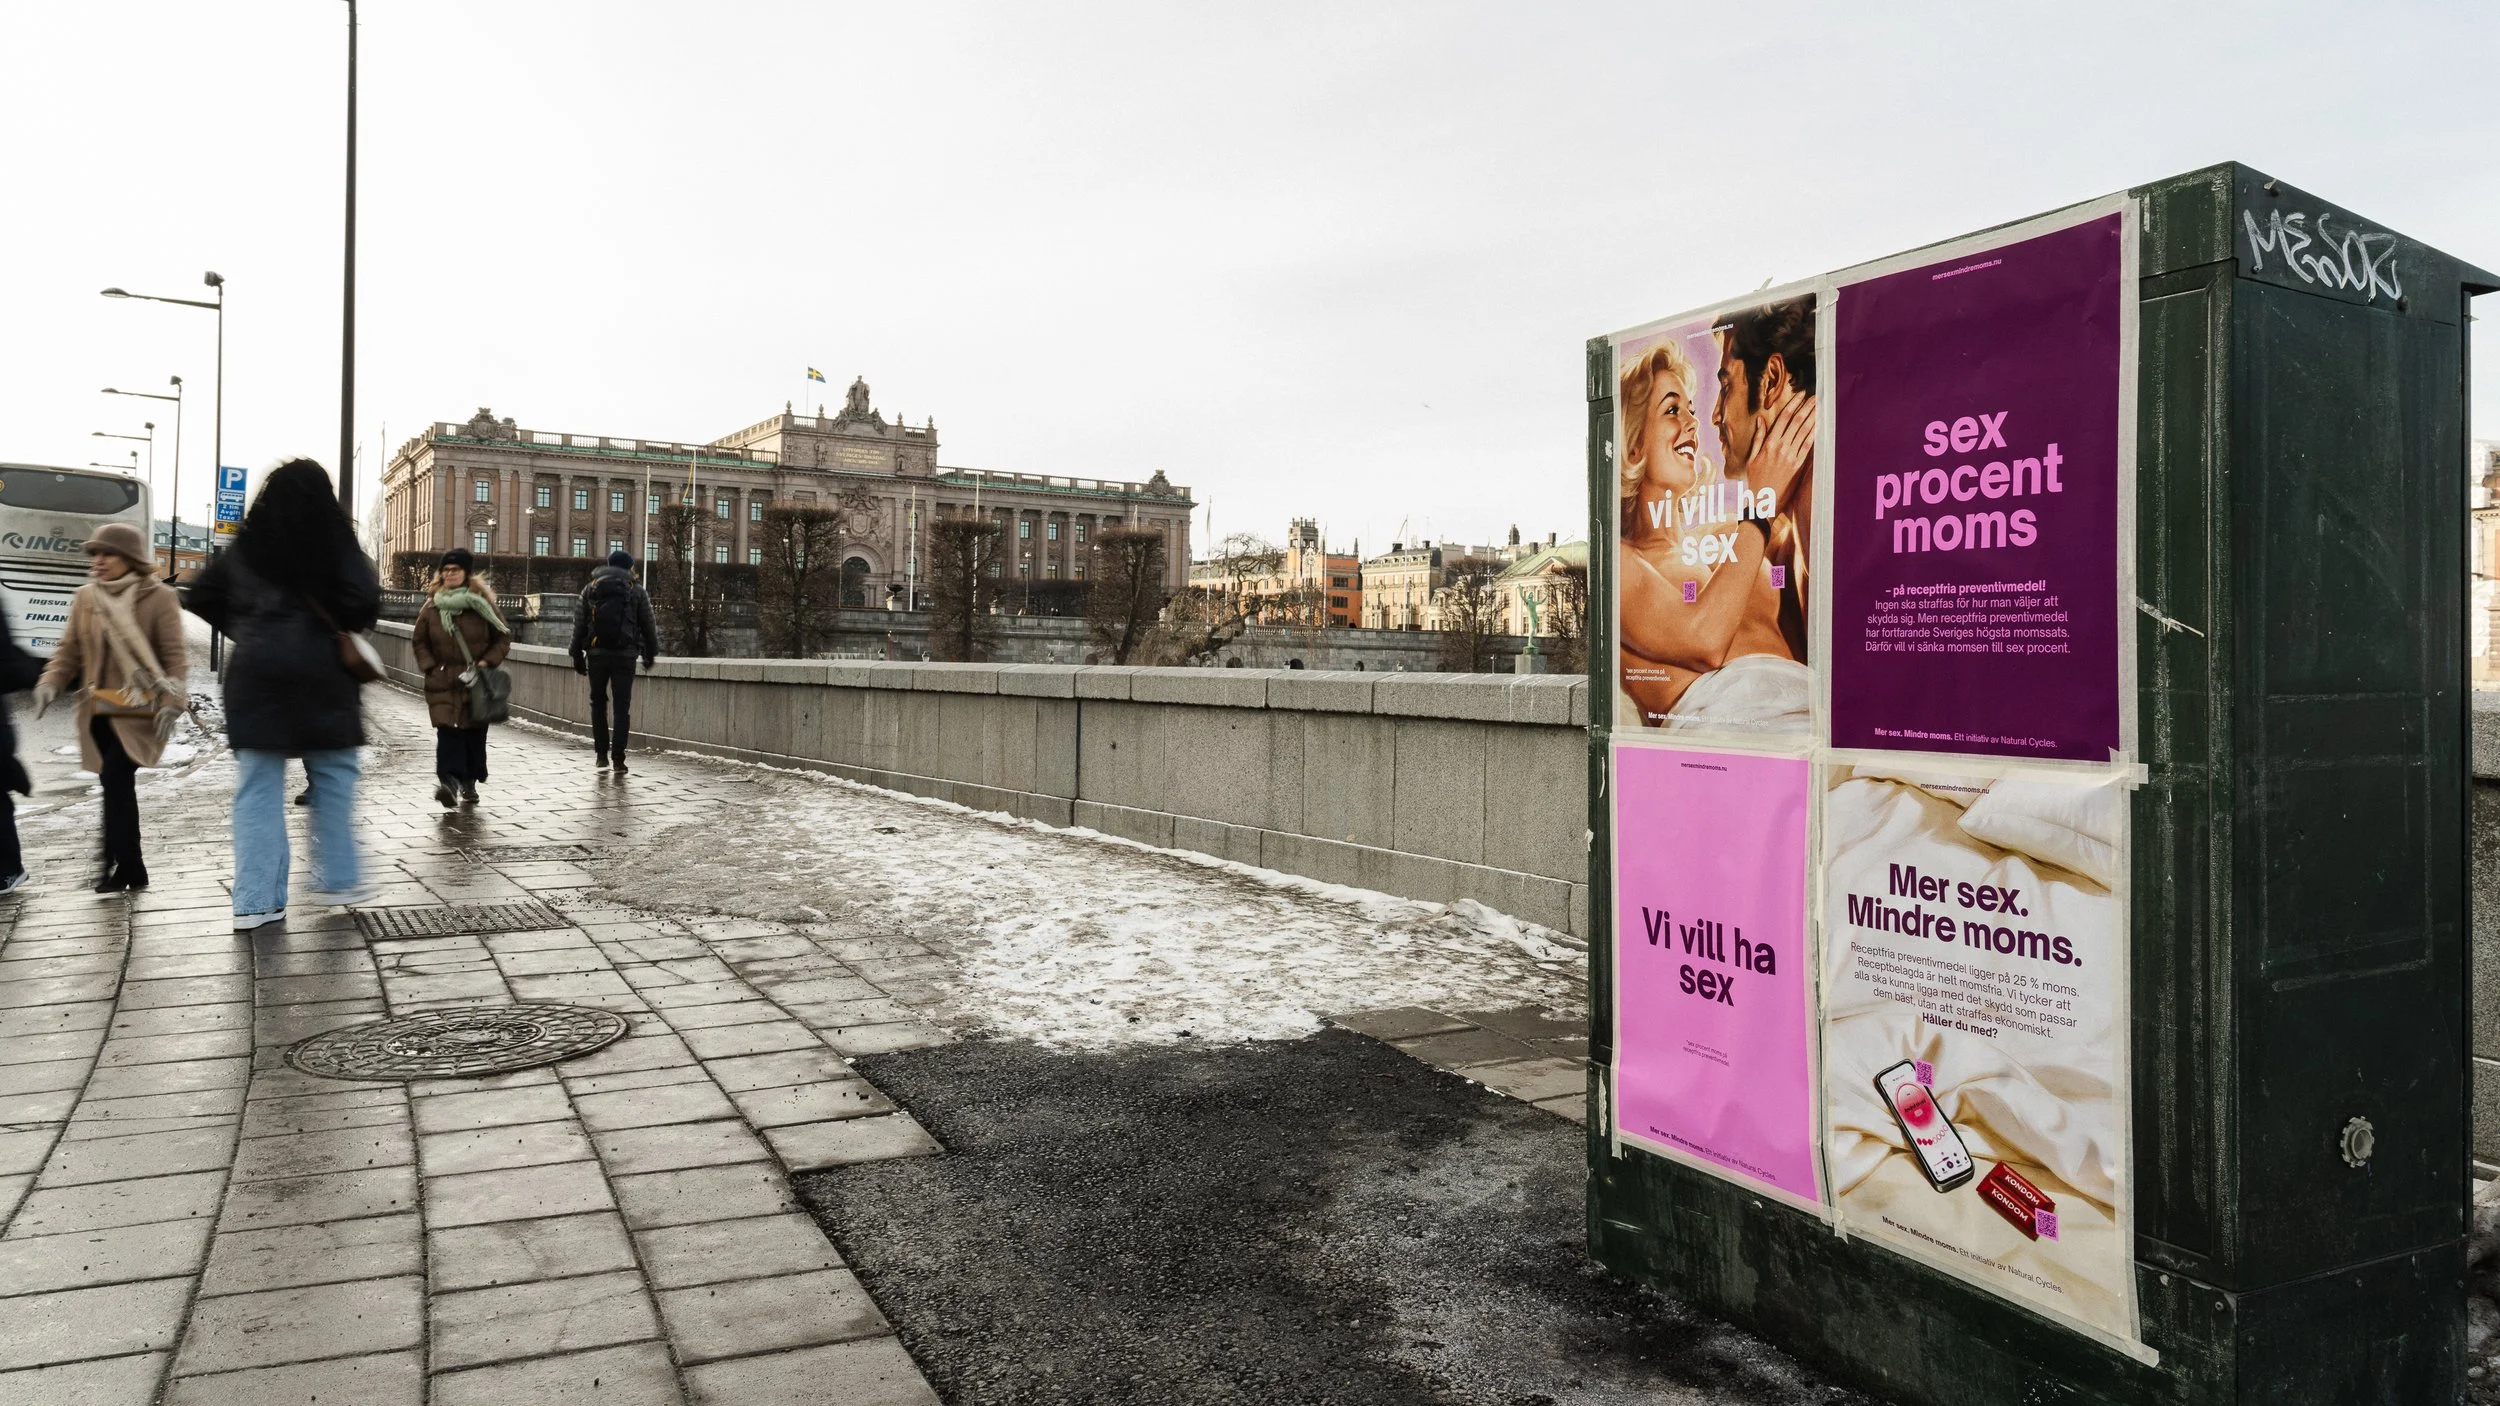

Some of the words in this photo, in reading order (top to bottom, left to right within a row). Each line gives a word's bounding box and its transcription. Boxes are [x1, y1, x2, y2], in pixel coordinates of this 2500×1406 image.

[1924, 411, 2008, 456] sex
[226, 469, 242, 488] P
[1876, 443, 2063, 520] procent
[1648, 490, 1672, 528] vi
[1680, 483, 1726, 526] vill
[1737, 481, 1776, 521] ha
[25, 536, 82, 552] INGS
[1894, 508, 2037, 553] moms
[1682, 532, 1738, 566] sex
[28, 598, 73, 607] ingsva.
[1875, 600, 1898, 612] Ingen
[1901, 600, 1916, 609] ska
[1918, 598, 1954, 609] straffas
[1956, 598, 1970, 608] för
[1972, 597, 1986, 608] hur
[1990, 598, 2012, 608] man
[2014, 596, 2042, 610] väljer
[2044, 596, 2059, 607] att
[1893, 584, 1904, 598] på
[1907, 583, 1956, 596] receptfria
[1958, 579, 2046, 596] preventivmedel!
[25, 613, 72, 622] FINLAN
[1866, 628, 1880, 638] har
[1882, 628, 1930, 638] fortfarande
[1933, 627, 1974, 640] Sveriges
[1976, 626, 2010, 640] högsta
[2014, 627, 2070, 638] momssats.
[1868, 613, 1898, 626] skydda
[1900, 612, 1916, 626] sig.
[1918, 613, 1938, 623] Men
[1941, 612, 1986, 625] receptfria
[1990, 611, 2068, 625] preventivmedel
[1866, 641, 1892, 652] Därför
[1894, 641, 1906, 652] vill
[1908, 642, 1916, 652] vi
[1917, 641, 1944, 652] sänka
[1948, 643, 1988, 653] momsen
[1992, 641, 2004, 653] till
[2006, 643, 2024, 653] sex
[2027, 642, 2070, 655] procent.
[1874, 728, 1887, 736] Mer
[1904, 730, 1928, 740] Mindre
[1930, 732, 1952, 741] moms.
[1954, 732, 1964, 742] Ett
[1966, 734, 1989, 743] initiativ
[1990, 736, 2000, 744] av
[2001, 735, 2027, 746] Natural
[2029, 738, 2058, 749] Cycles.
[1920, 782, 1990, 794] mersexmindremoms.nu
[1890, 862, 1950, 903] Mer
[1957, 882, 2028, 917] sex.
[1642, 906, 1670, 949] Vi
[1679, 918, 1726, 963] vill
[1734, 927, 1776, 976] ha
[1848, 894, 1956, 942] Mindre
[1964, 920, 2082, 967] moms.
[1680, 964, 1734, 1007] sex
[1850, 942, 1895, 959] Receptfria
[1898, 952, 1967, 974] preventivmedel
[1969, 964, 1996, 982] ligger
[1998, 972, 2010, 985] på
[2014, 974, 2027, 987] 25
[2030, 978, 2040, 989] %
[2042, 983, 2080, 998] moms.
[1858, 957, 1924, 980] Receptbelagda
[1926, 970, 1936, 981] är
[1938, 973, 1958, 986] helt
[1960, 976, 2004, 997] momsfria.
[2007, 988, 2017, 1000] Vi
[2019, 990, 2052, 1008] tycker
[2056, 998, 2071, 1012] att
[1854, 969, 1870, 982] alla
[1872, 973, 1888, 986] ska
[1889, 977, 1915, 992] kunna
[1916, 982, 1938, 999] ligga
[1941, 987, 1964, 1002] med
[1966, 992, 1982, 1006] det
[1984, 997, 2012, 1014] skydd
[2015, 1006, 2036, 1019] som
[2040, 1010, 2078, 1028] passar
[1874, 987, 1893, 1000] dem
[1894, 991, 1916, 1007] bäst,
[1918, 998, 1937, 1011] utan
[1940, 1002, 1954, 1014] att
[1956, 1006, 1992, 1024] straffas
[1995, 1014, 2054, 1038] ekonomiskt.
[1922, 1012, 1952, 1028] Håller
[1956, 1019, 1968, 1032] du
[1970, 1022, 1998, 1039] med?
[1650, 1126, 1660, 1135] Mer
[1660, 1130, 1670, 1139] sex.
[1671, 1133, 1688, 1146] Mindre
[1992, 1188, 2028, 1222] KONDOM
[2004, 1174, 2040, 1206] KONDOM
[1882, 1215, 1894, 1228] Mer
[1896, 1222, 1910, 1234] sex.
[1910, 1227, 1934, 1244] Mindre
[1936, 1238, 1958, 1254] moms.
[1960, 1247, 1970, 1258] Ett
[1970, 1250, 1996, 1268] initiativ
[1998, 1262, 2006, 1272] av
[2008, 1264, 2034, 1283] Natural
[2036, 1276, 2064, 1295] Cycles.
